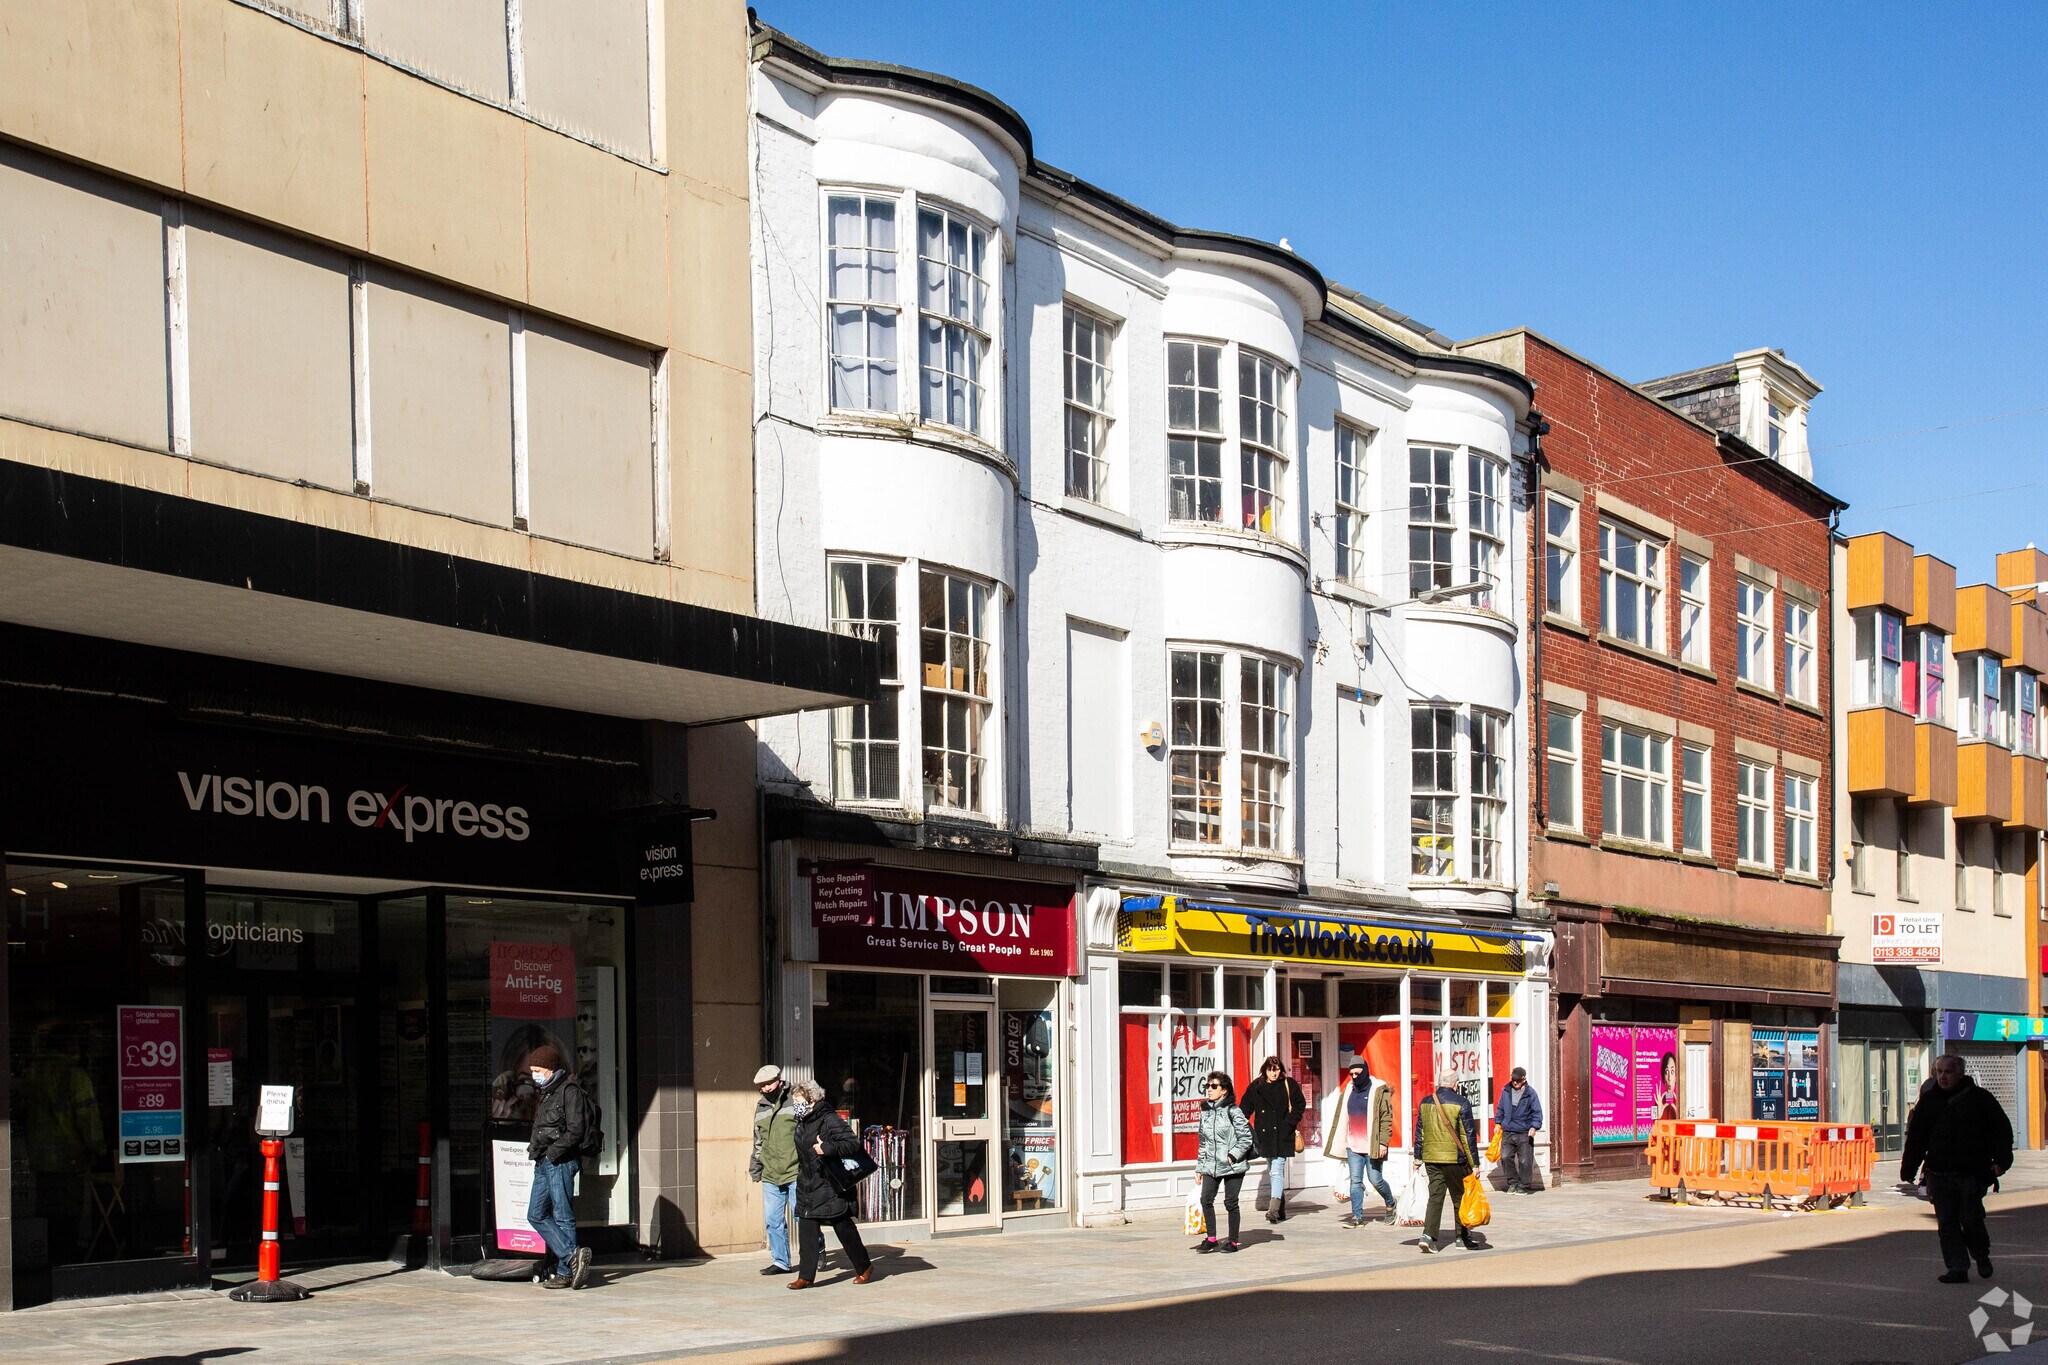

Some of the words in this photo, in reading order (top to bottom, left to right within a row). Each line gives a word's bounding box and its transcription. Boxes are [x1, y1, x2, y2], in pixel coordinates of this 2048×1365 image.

[178, 771, 331, 824] vision
[347, 784, 530, 843] express
[645, 844, 677, 861] vision
[640, 864, 683, 882] express
[816, 875, 835, 884] Shoe
[836, 873, 865, 884] Repairs
[818, 888, 833, 898] Key
[834, 886, 863, 896] Cutting
[814, 900, 837, 910] Watch
[838, 899, 868, 909] Repairs
[822, 912, 860, 923] Engraving
[872, 891, 1033, 938] IMPSON
[1145, 910, 1162, 921] The
[207, 920, 303, 944] opticians
[1139, 921, 1168, 932] Works
[1899, 924, 1915, 934] TO
[1918, 924, 1940, 934] LET
[866, 934, 896, 948] Great
[899, 936, 939, 950] Service
[942, 939, 955, 953] By
[958, 940, 986, 954] Great
[988, 942, 1022, 957] People
[1245, 915, 1435, 965] TheWorks.co.uk
[1029, 947, 1040, 956] Est
[1040, 948, 1054, 957] 1903
[1874, 947, 1894, 957] 0113
[1896, 947, 1914, 957] 388
[1915, 947, 1939, 957] 4848
[514, 960, 552, 972] Discover
[505, 973, 563, 994] Anti-Fog
[519, 992, 549, 1003] lenses
[135, 1011, 155, 1019] Single
[1007, 1013, 1020, 1038] KEY
[126, 1041, 177, 1067] £39
[1007, 1039, 1020, 1067] CAR
[1435, 1051, 1467, 1074] MST
[266, 1090, 288, 1098] Please
[139, 1093, 165, 1108] £89
[1030, 1136, 1050, 1145] PRICE
